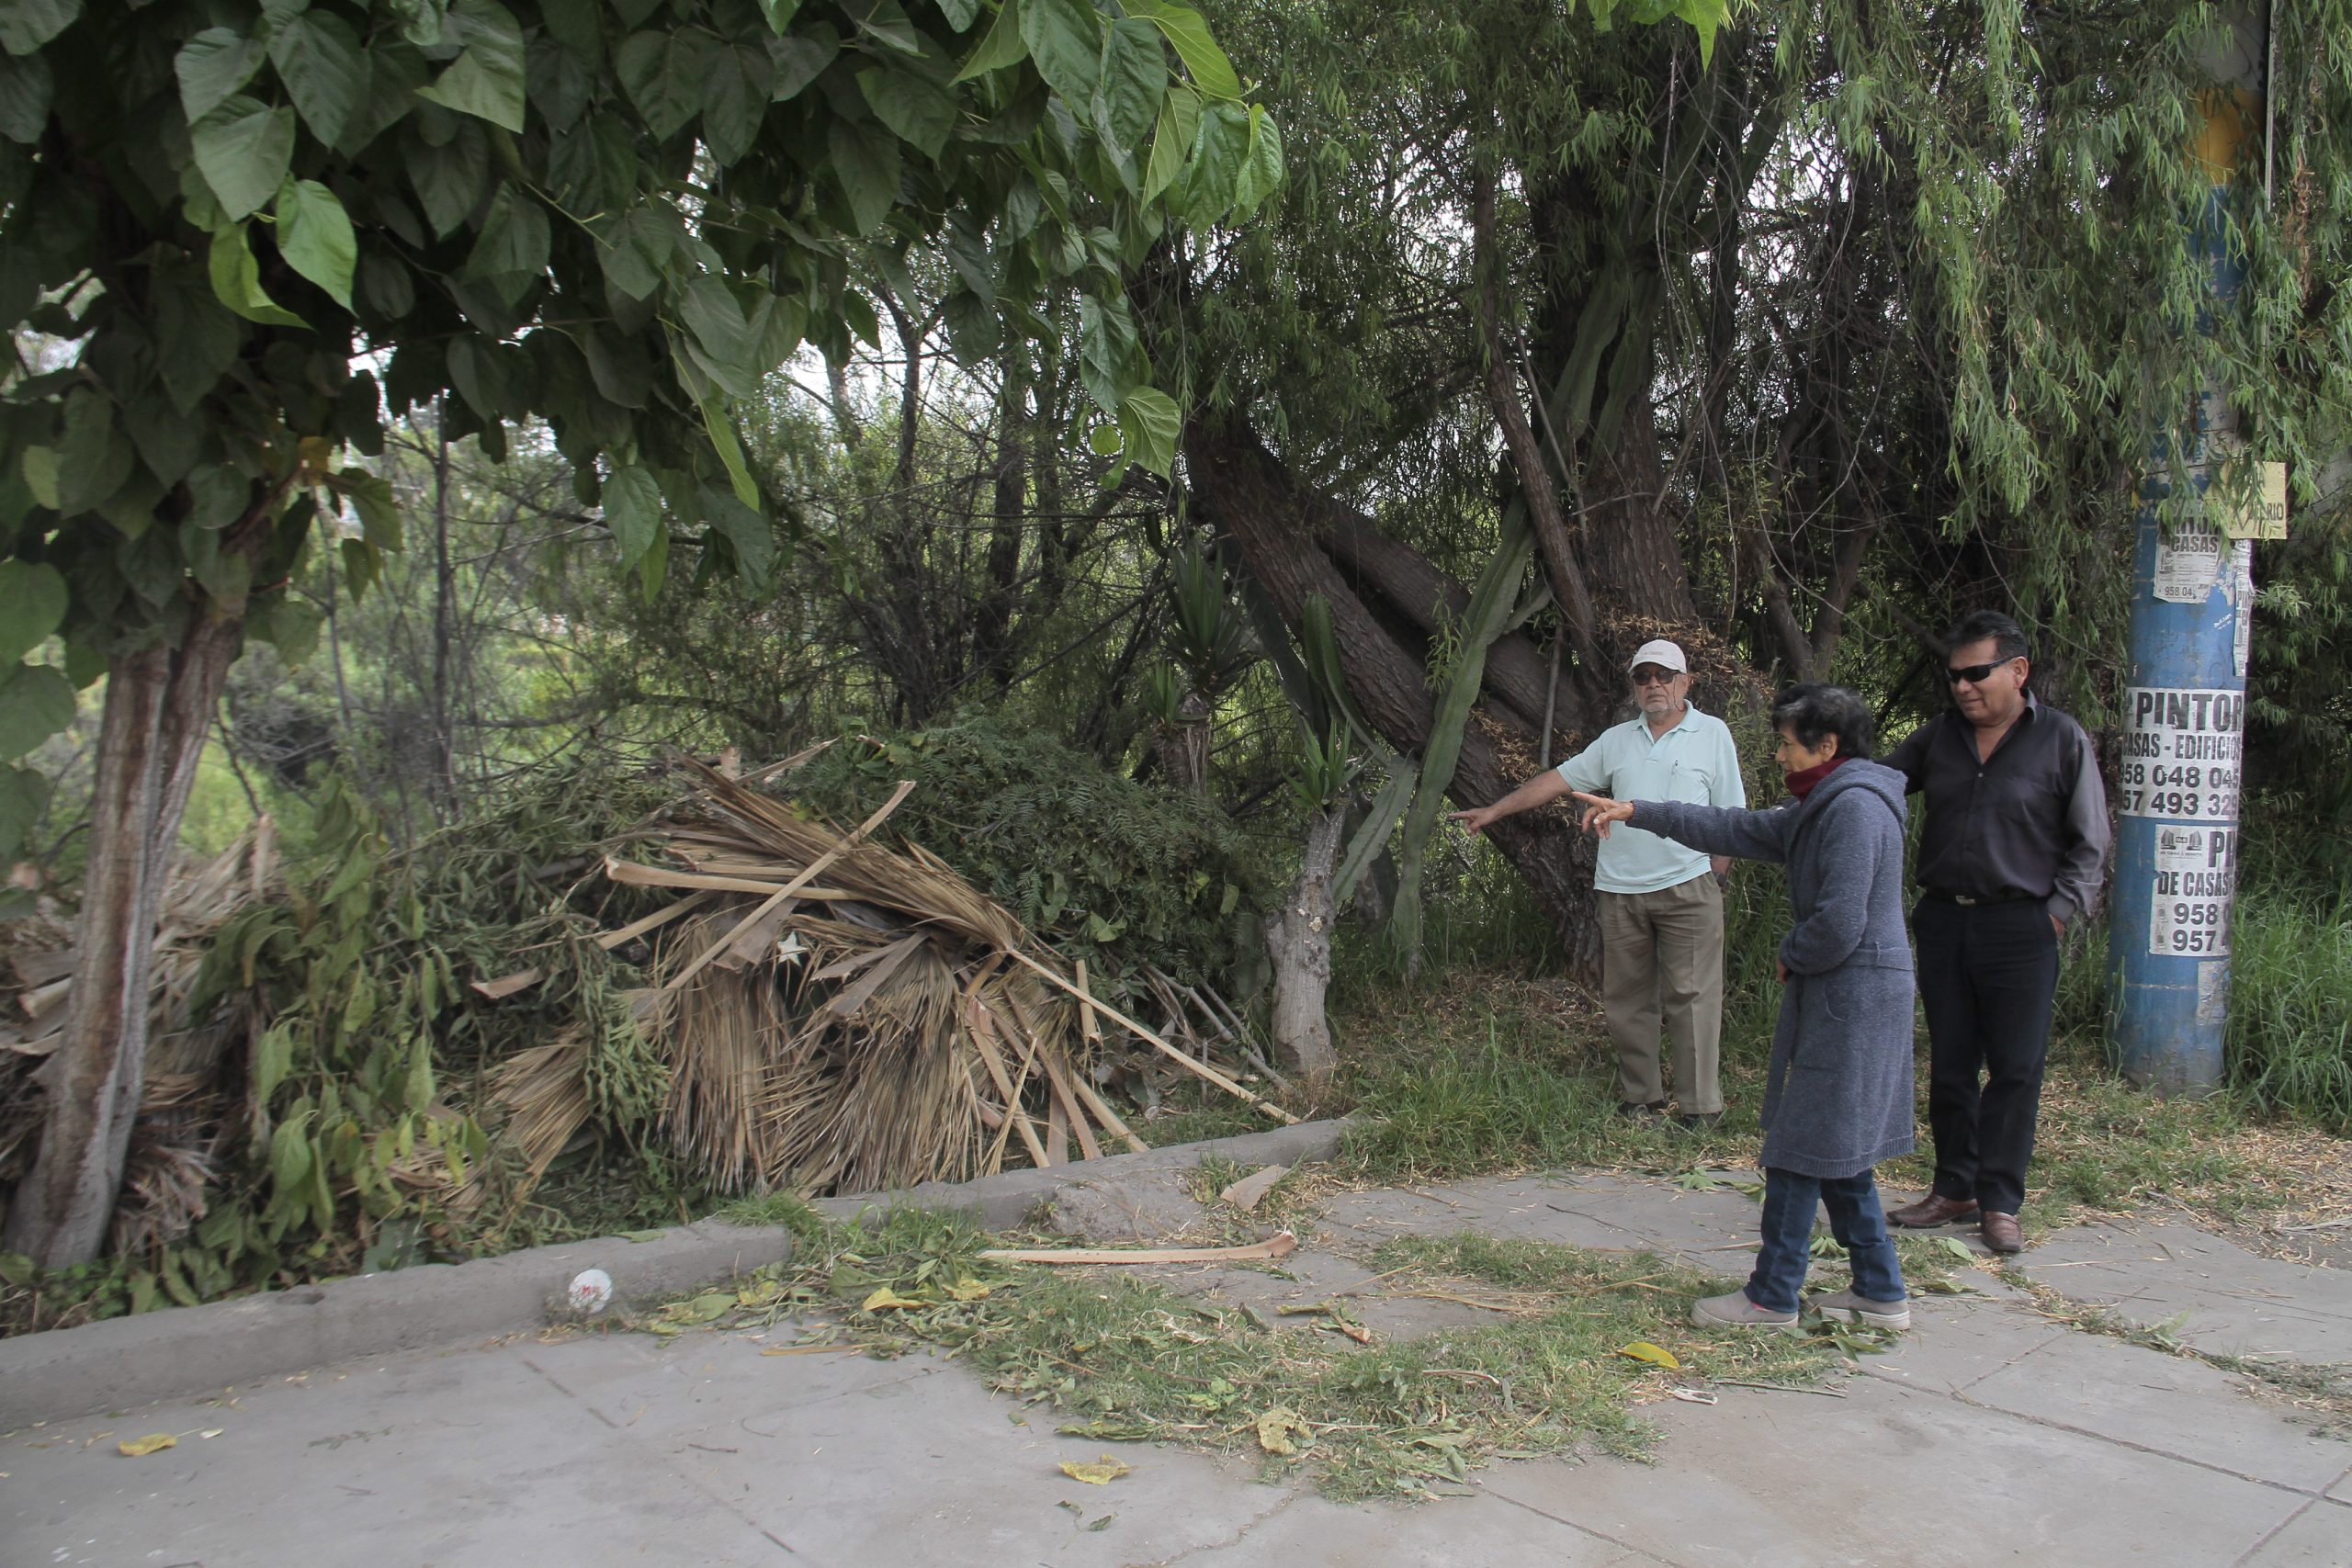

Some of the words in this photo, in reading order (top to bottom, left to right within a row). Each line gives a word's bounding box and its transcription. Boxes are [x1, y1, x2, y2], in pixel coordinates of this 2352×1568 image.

[2171, 536, 2219, 553] CASAS
[2165, 586, 2180, 597] 958
[2135, 692, 2243, 733] PINTOR
[2152, 764, 2201, 788] 048
[2151, 792, 2199, 816] 493
[2207, 794, 2238, 817] 329
[2157, 871, 2179, 895] DE
[2183, 872, 2229, 897] CASAS
[2174, 902, 2219, 925] 958
[2172, 930, 2217, 953] 957
